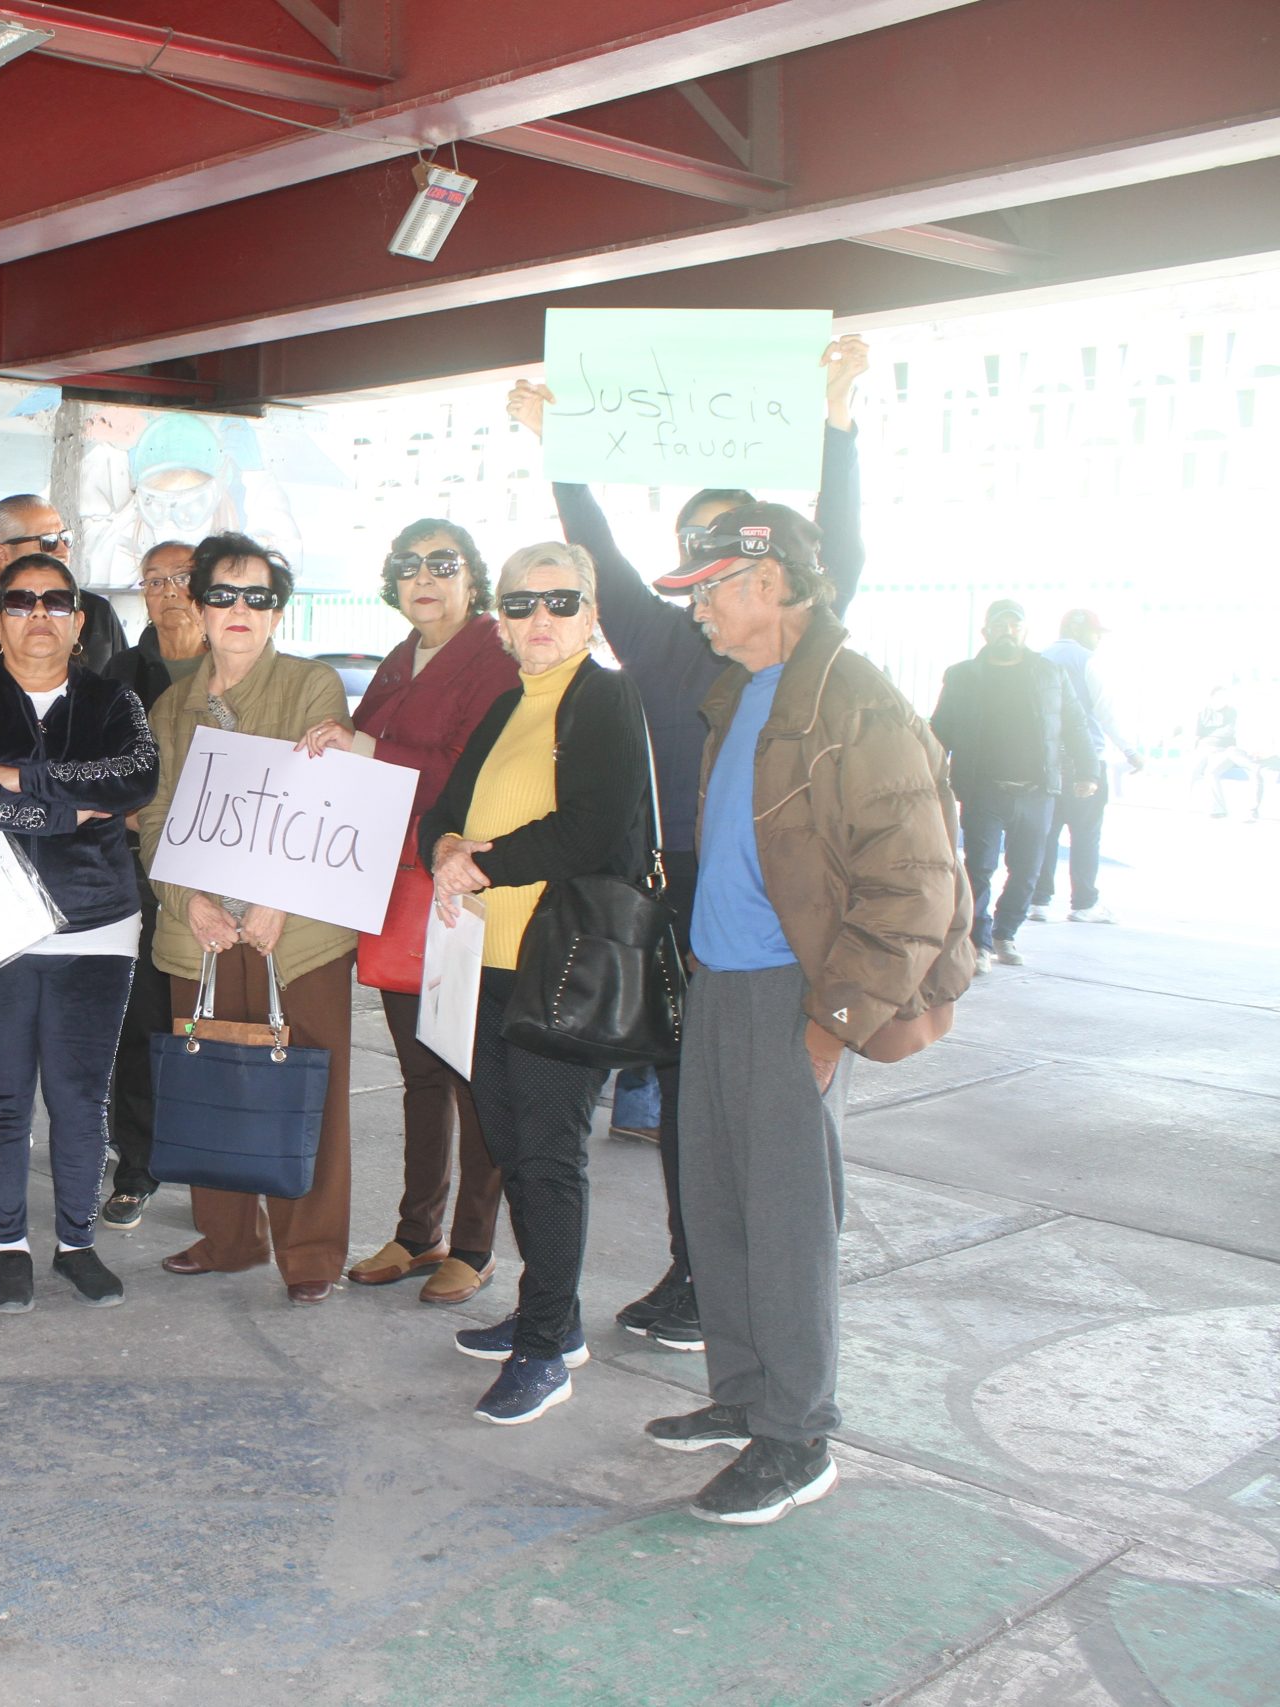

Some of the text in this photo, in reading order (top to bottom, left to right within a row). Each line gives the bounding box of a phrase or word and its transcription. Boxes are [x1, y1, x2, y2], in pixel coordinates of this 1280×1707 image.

[549, 346, 791, 426] Justicia
[653, 421, 763, 460] favor
[745, 540, 766, 550] WA
[167, 752, 364, 872] Justicia
